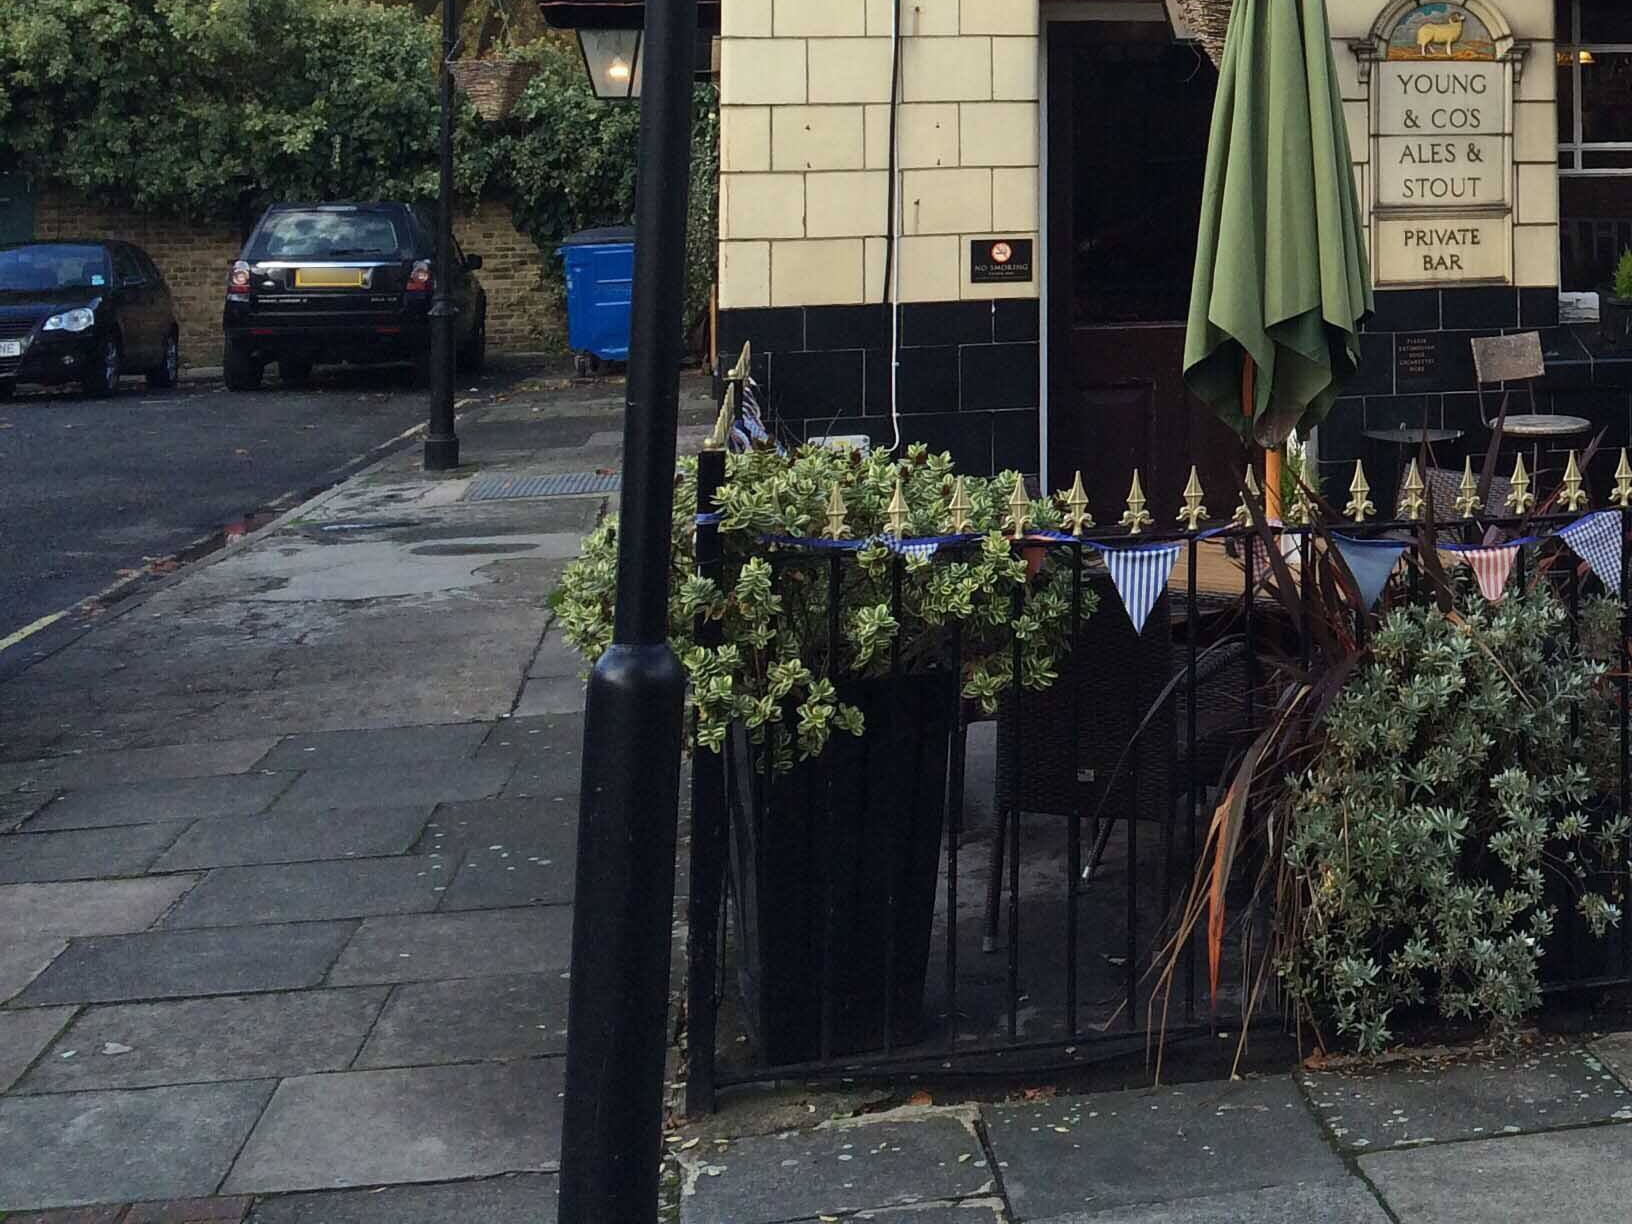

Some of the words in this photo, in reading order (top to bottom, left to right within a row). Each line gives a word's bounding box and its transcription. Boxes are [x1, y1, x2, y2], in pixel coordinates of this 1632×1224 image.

[1397, 74, 1487, 95] YOUNG
[1403, 109, 1421, 129] &
[1399, 143, 1457, 164] ALES
[1467, 143, 1484, 163] &
[1402, 177, 1481, 199] STOUT
[1404, 228, 1481, 246] PRIVATE
[974, 264, 988, 272] NO
[990, 263, 1029, 272] SMOKING
[1423, 254, 1464, 271] BAR
